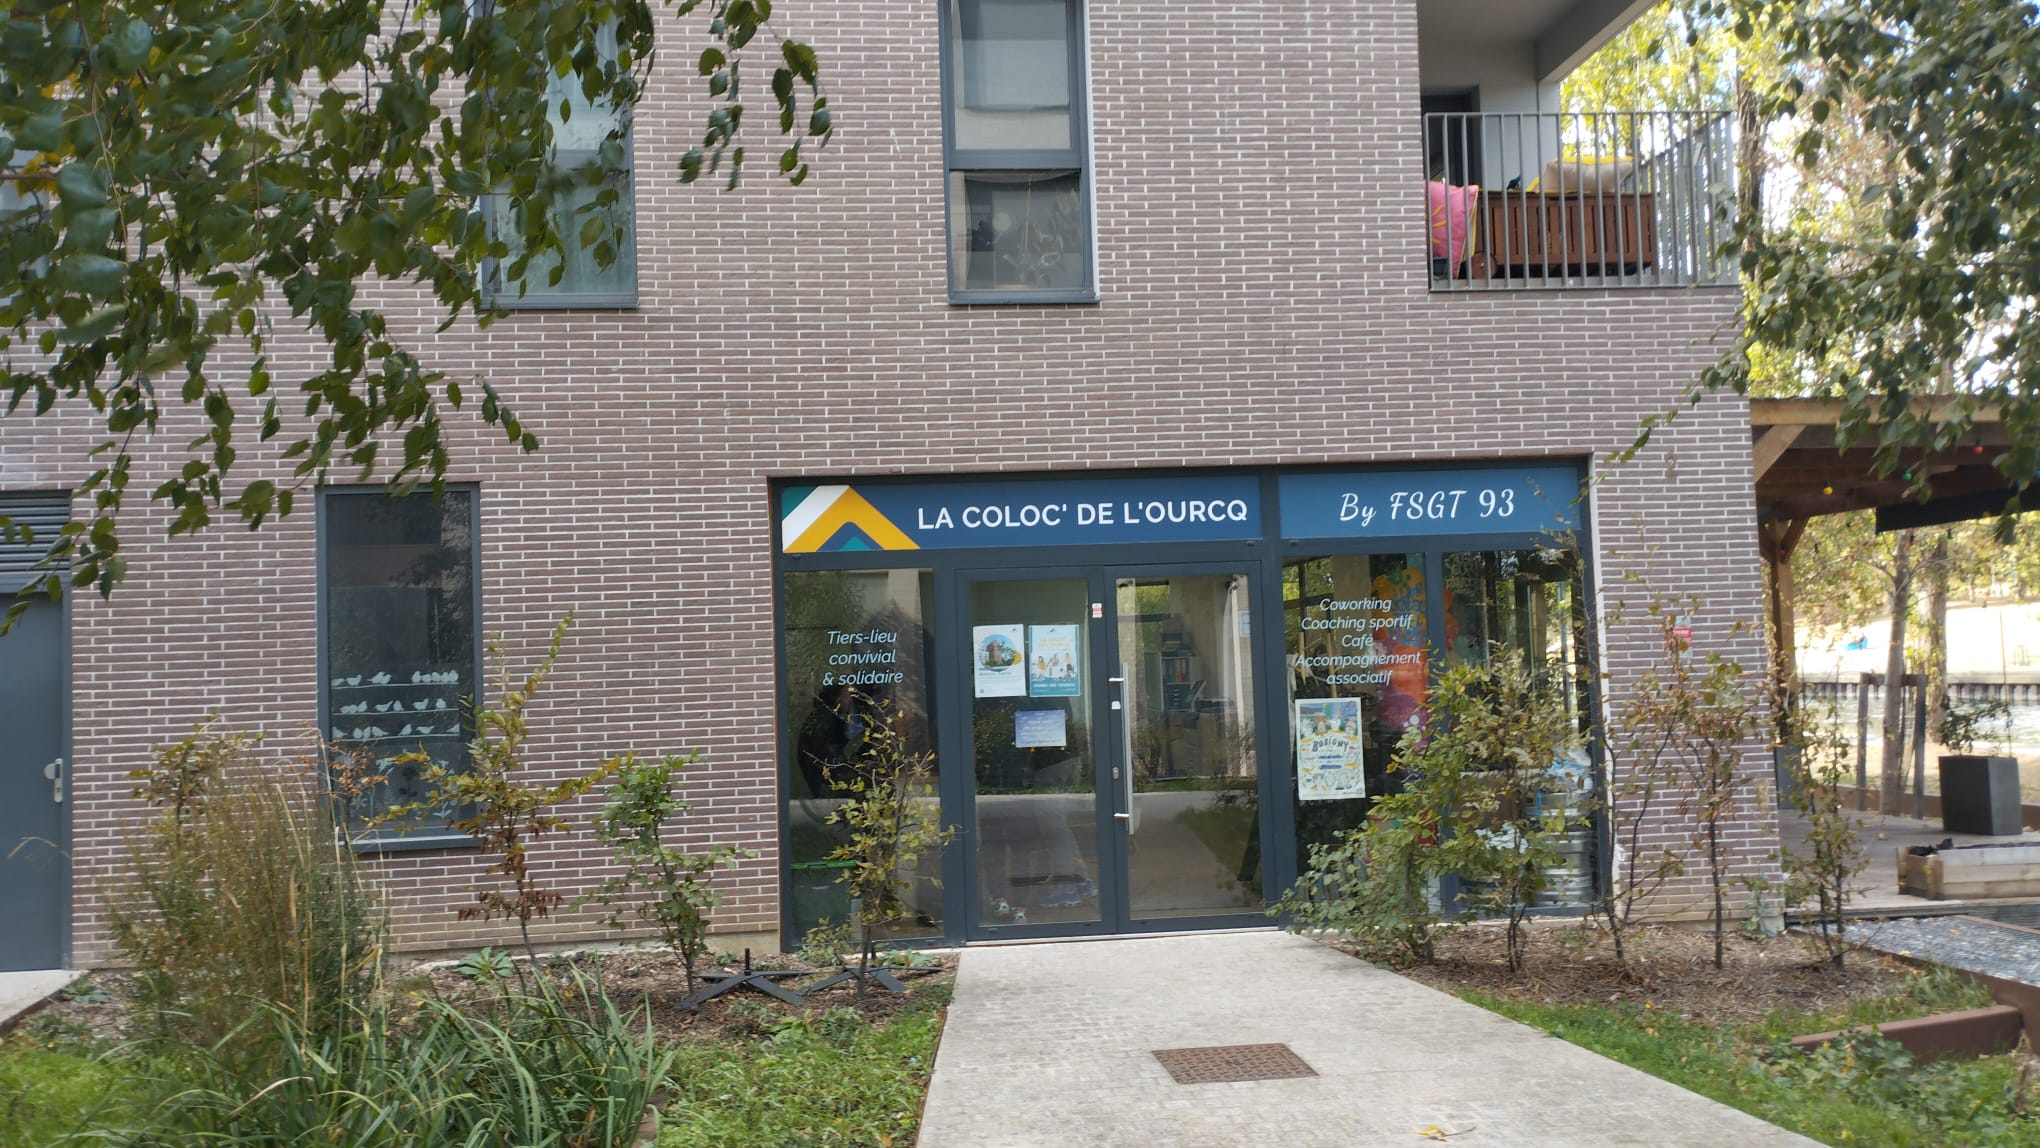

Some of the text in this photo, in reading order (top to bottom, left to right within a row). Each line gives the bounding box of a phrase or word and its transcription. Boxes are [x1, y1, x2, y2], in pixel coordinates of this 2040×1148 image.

[918, 500, 1247, 529] LA COLOC' DE L'OURCQ
[1339, 488, 1515, 527] By FSGT 93
[1319, 597, 1392, 613] Coworking
[1301, 614, 1414, 631] Coaching sportif
[827, 629, 897, 645] Tiers-lieu
[1341, 634, 1374, 650] Café
[829, 649, 896, 665] convivial
[1295, 652, 1422, 668] Accompagnement
[822, 670, 903, 686] & solidaire
[1326, 670, 1393, 685] associatif
